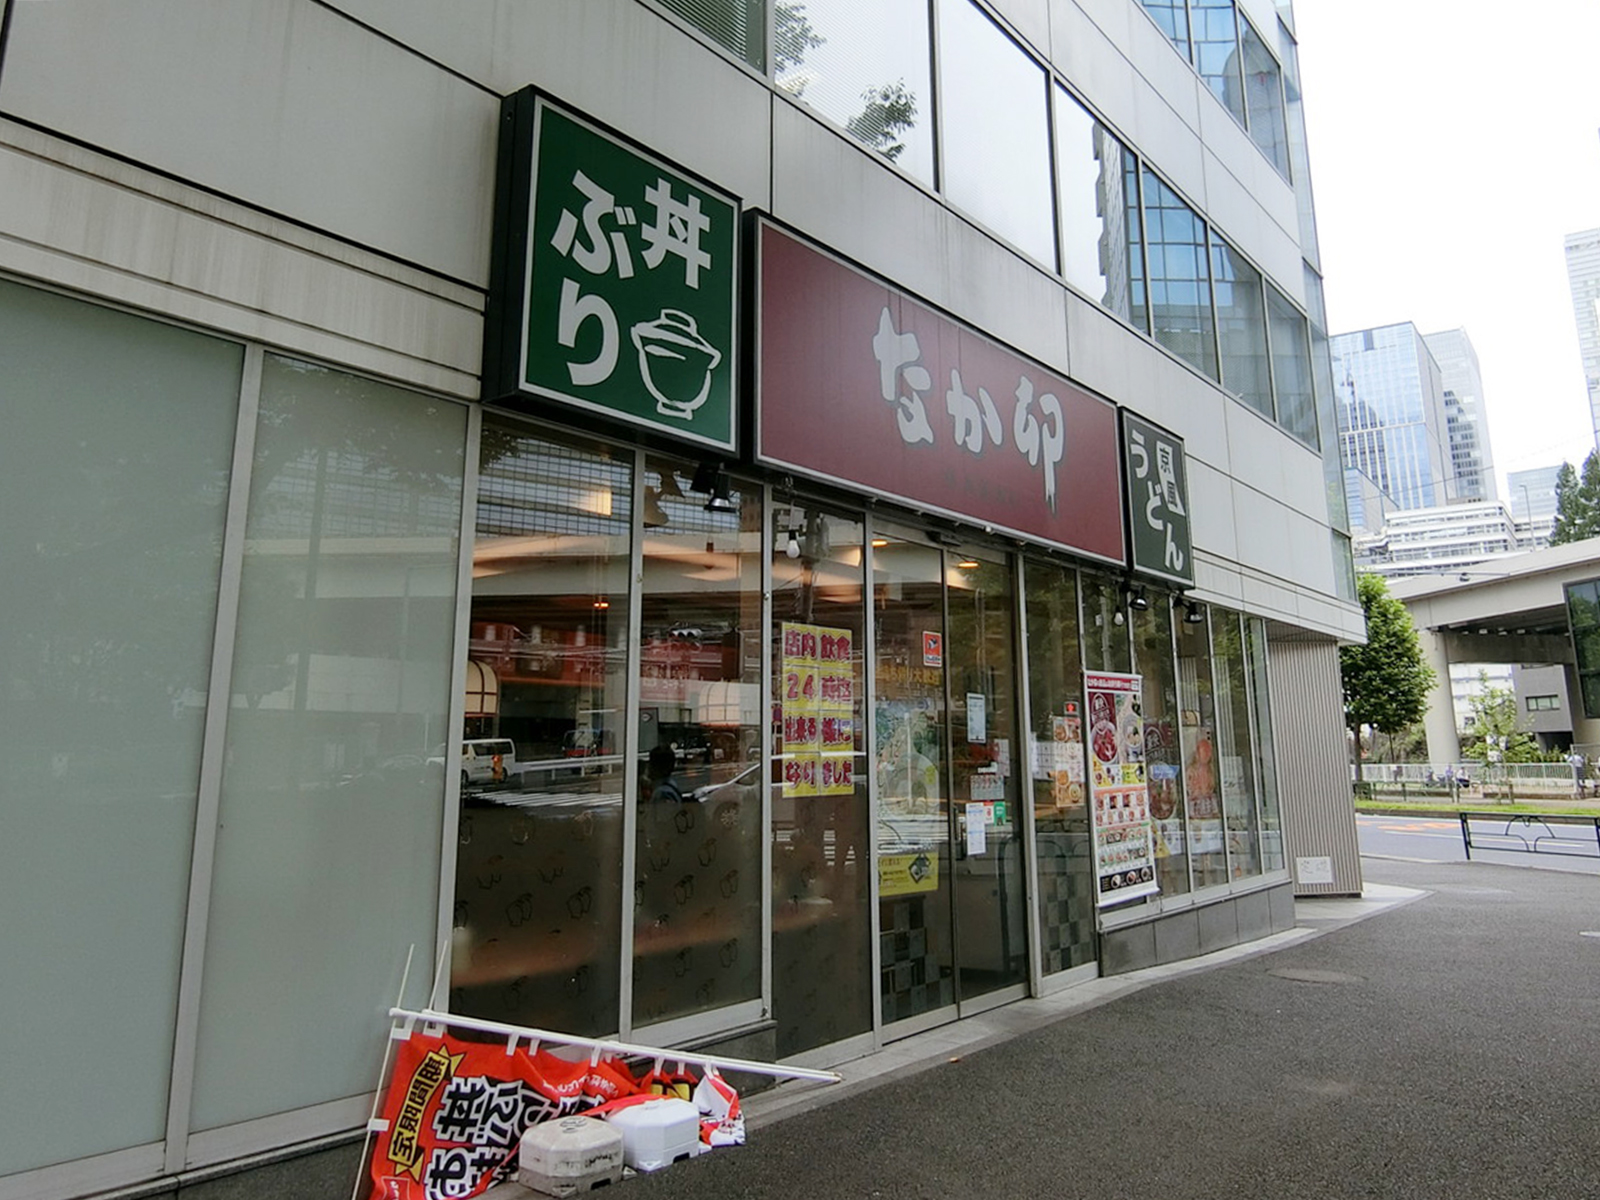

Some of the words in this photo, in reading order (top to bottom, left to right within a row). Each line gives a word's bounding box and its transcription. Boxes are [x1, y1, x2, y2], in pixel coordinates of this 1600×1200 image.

[872, 306, 1065, 519] なか卯
[1129, 428, 1184, 573] うどん
